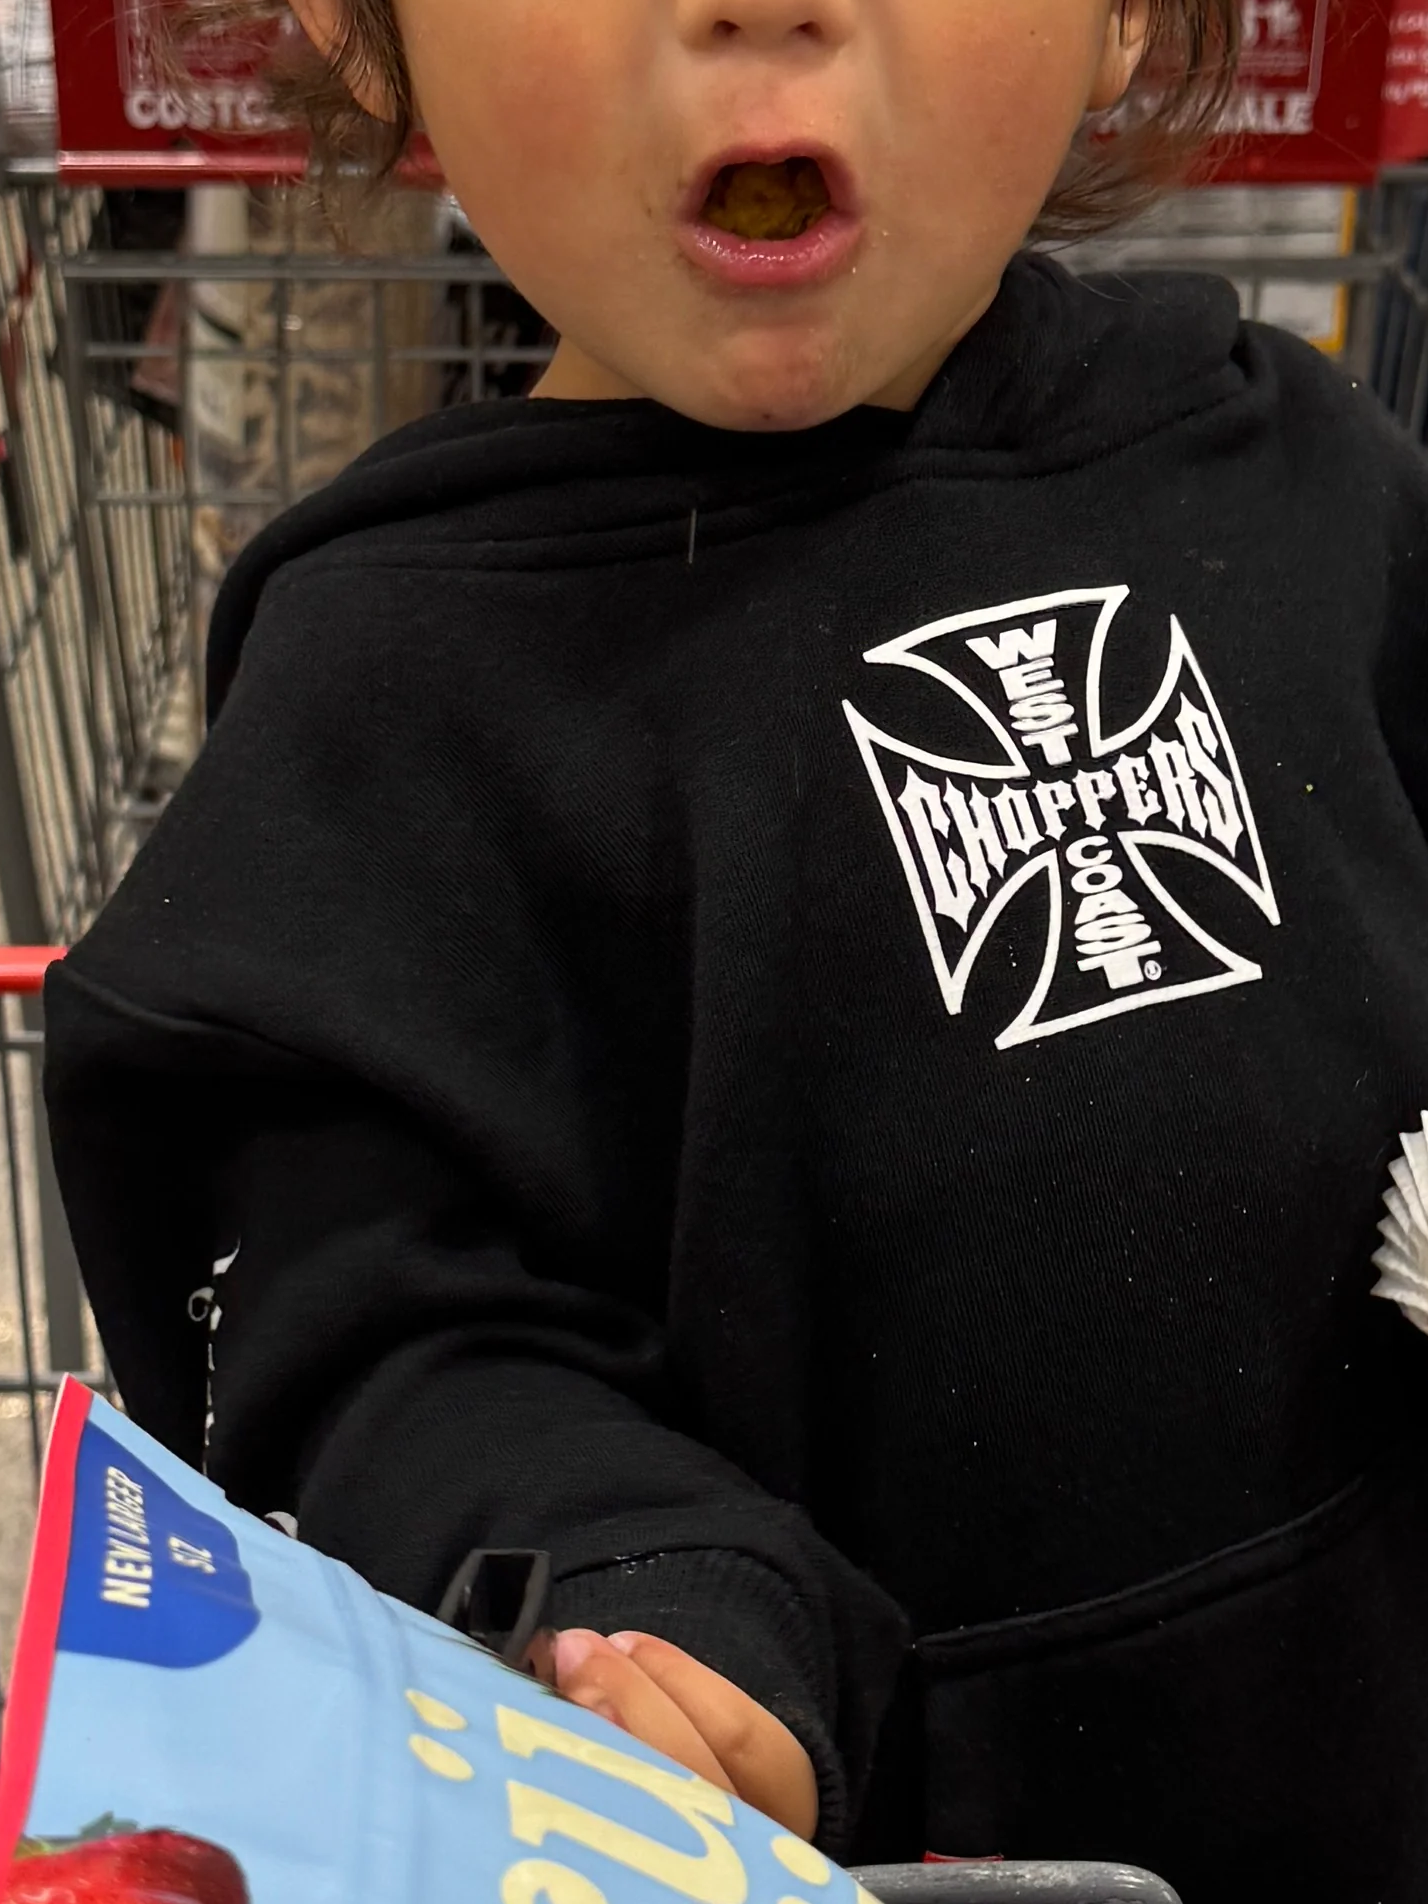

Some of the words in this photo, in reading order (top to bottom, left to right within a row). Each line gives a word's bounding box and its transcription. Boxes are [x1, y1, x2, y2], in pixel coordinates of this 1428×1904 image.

[124, 89, 288, 130] COSTC
[966, 618, 1079, 765] WEST
[898, 691, 1243, 933] CHOPPERS
[1069, 835, 1162, 990] COAST
